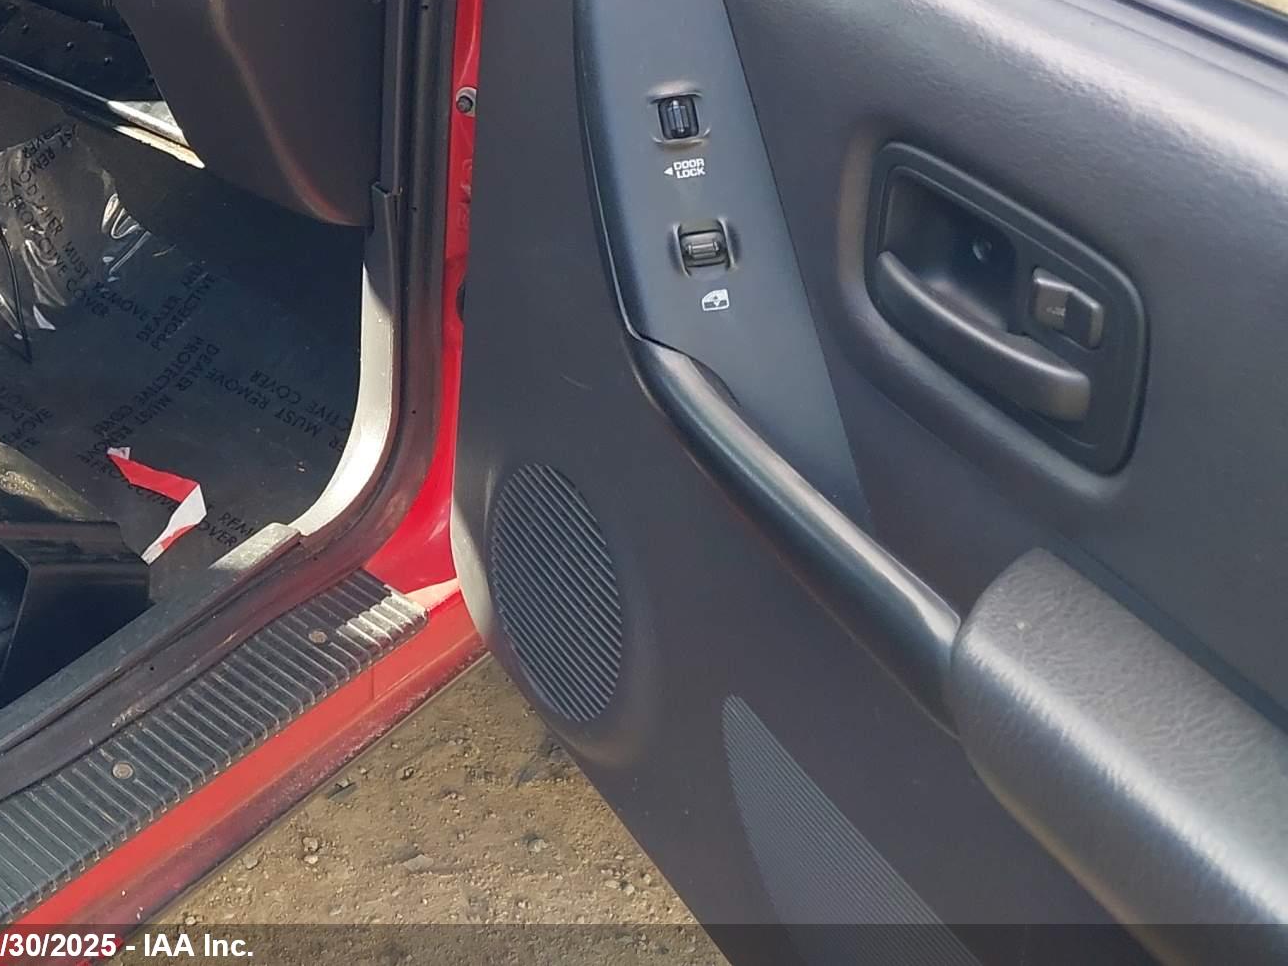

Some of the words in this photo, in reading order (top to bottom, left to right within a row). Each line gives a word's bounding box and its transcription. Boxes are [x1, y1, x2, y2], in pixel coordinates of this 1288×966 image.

[673, 158, 705, 170] DOOR
[676, 167, 706, 179] LOCK
[131, 333, 207, 409] PROTECTIVE
[173, 340, 222, 395] DEALER
[203, 364, 272, 412] REMOVE
[247, 365, 304, 410] COVER
[272, 402, 322, 442] MUST
